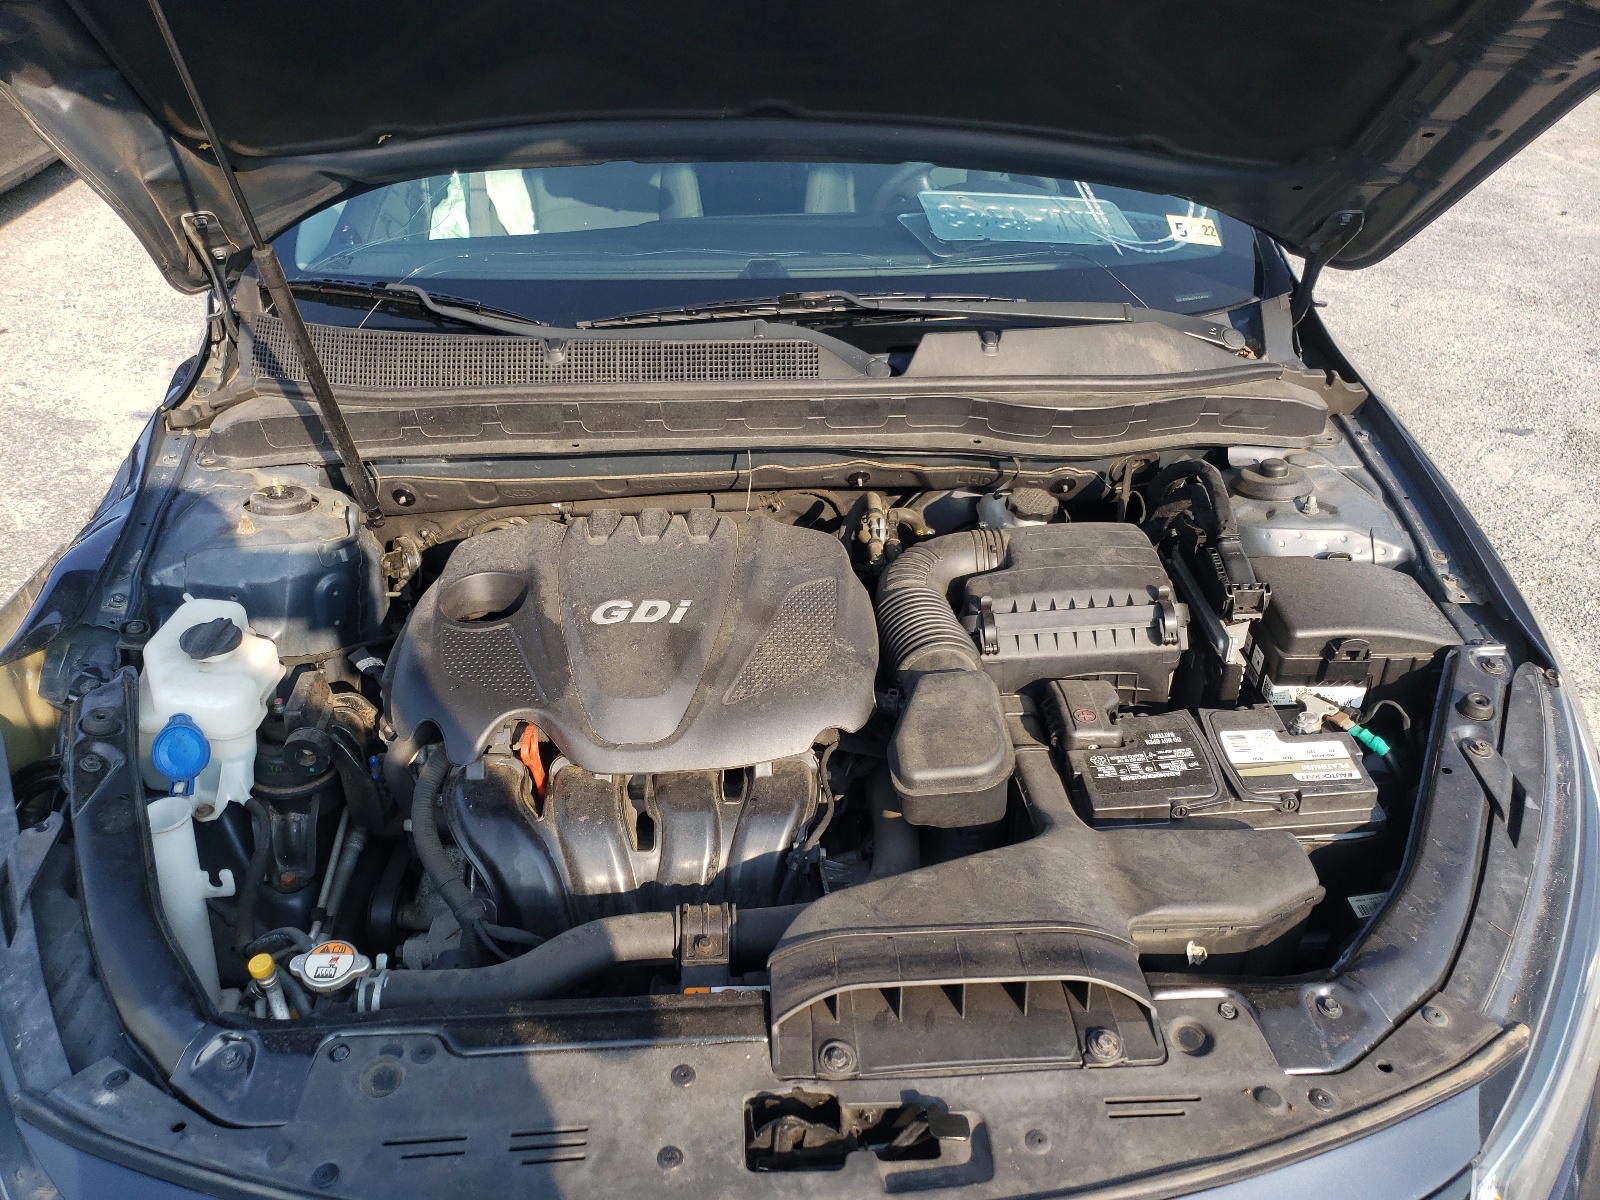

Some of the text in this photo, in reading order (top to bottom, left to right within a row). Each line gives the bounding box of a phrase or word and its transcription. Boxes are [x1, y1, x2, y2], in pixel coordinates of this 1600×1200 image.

[1175, 222, 1217, 237] 5 22
[590, 599, 694, 625] GDi
[1301, 762, 1350, 771] PLATINUM
